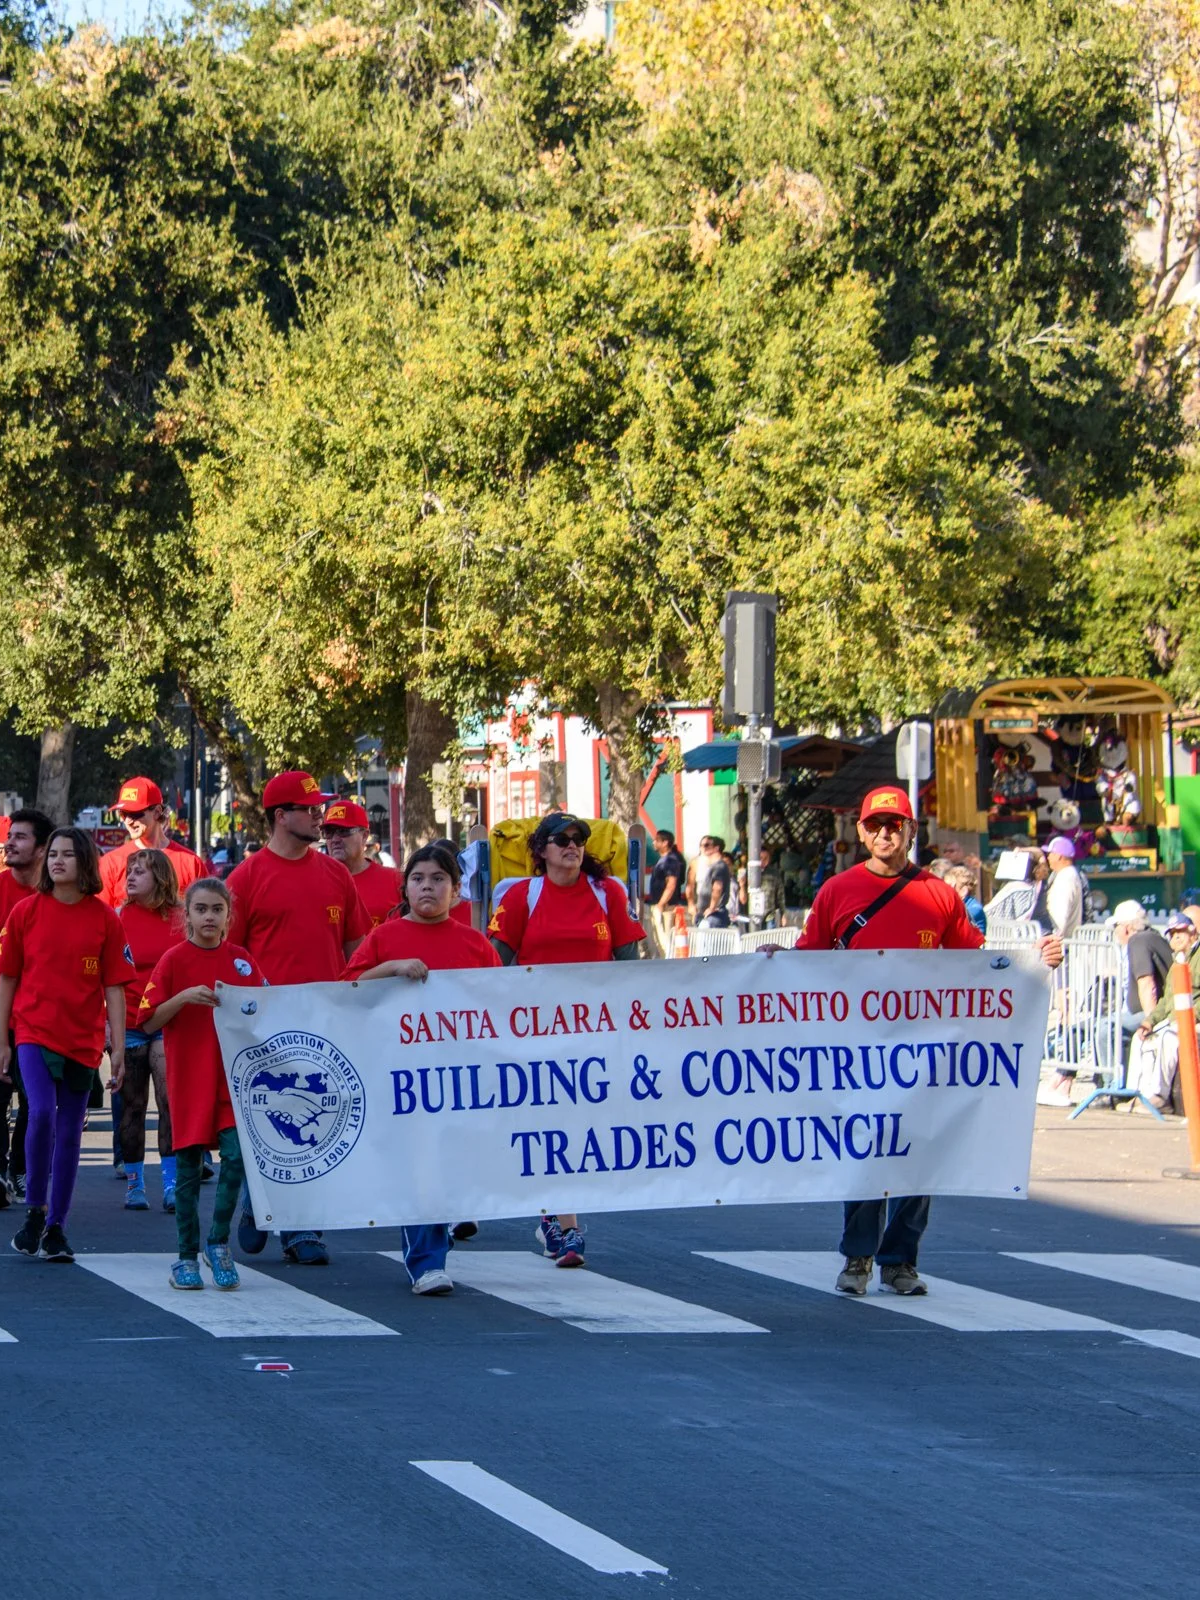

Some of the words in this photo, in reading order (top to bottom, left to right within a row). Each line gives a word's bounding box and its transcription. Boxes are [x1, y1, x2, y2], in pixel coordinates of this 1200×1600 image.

[921, 933, 933, 944] UA
[85, 959, 98, 969] UA
[400, 1010, 497, 1044] SANTA
[509, 1003, 614, 1037] CLARA
[630, 1001, 651, 1031] &
[664, 996, 722, 1028] SAN
[739, 991, 849, 1023] BENITO
[861, 988, 1012, 1021] COUNTIES
[244, 1061, 268, 1093] AMERICAN
[270, 1050, 310, 1065] FEDERATION
[312, 1053, 322, 1062] OF
[322, 1060, 342, 1083] LABOR
[245, 1034, 325, 1061] CONSTRUCTION
[328, 1047, 360, 1092] TRADES
[391, 1056, 611, 1116] BUILDING
[629, 1053, 663, 1101] &
[681, 1040, 1024, 1098] CONSTRUCTION
[252, 1094, 268, 1105] AFL
[321, 1095, 337, 1107] CIO
[243, 1106, 263, 1150] CONGRESS
[263, 1148, 271, 1157] OF
[272, 1153, 313, 1164] INDUSTRIAL
[314, 1099, 348, 1155] ORGANIZATIONS
[510, 1121, 697, 1177] TRADES
[715, 1113, 912, 1166] COUNCIL
[272, 1167, 296, 1181] FEB.
[323, 1139, 350, 1167] 1908
